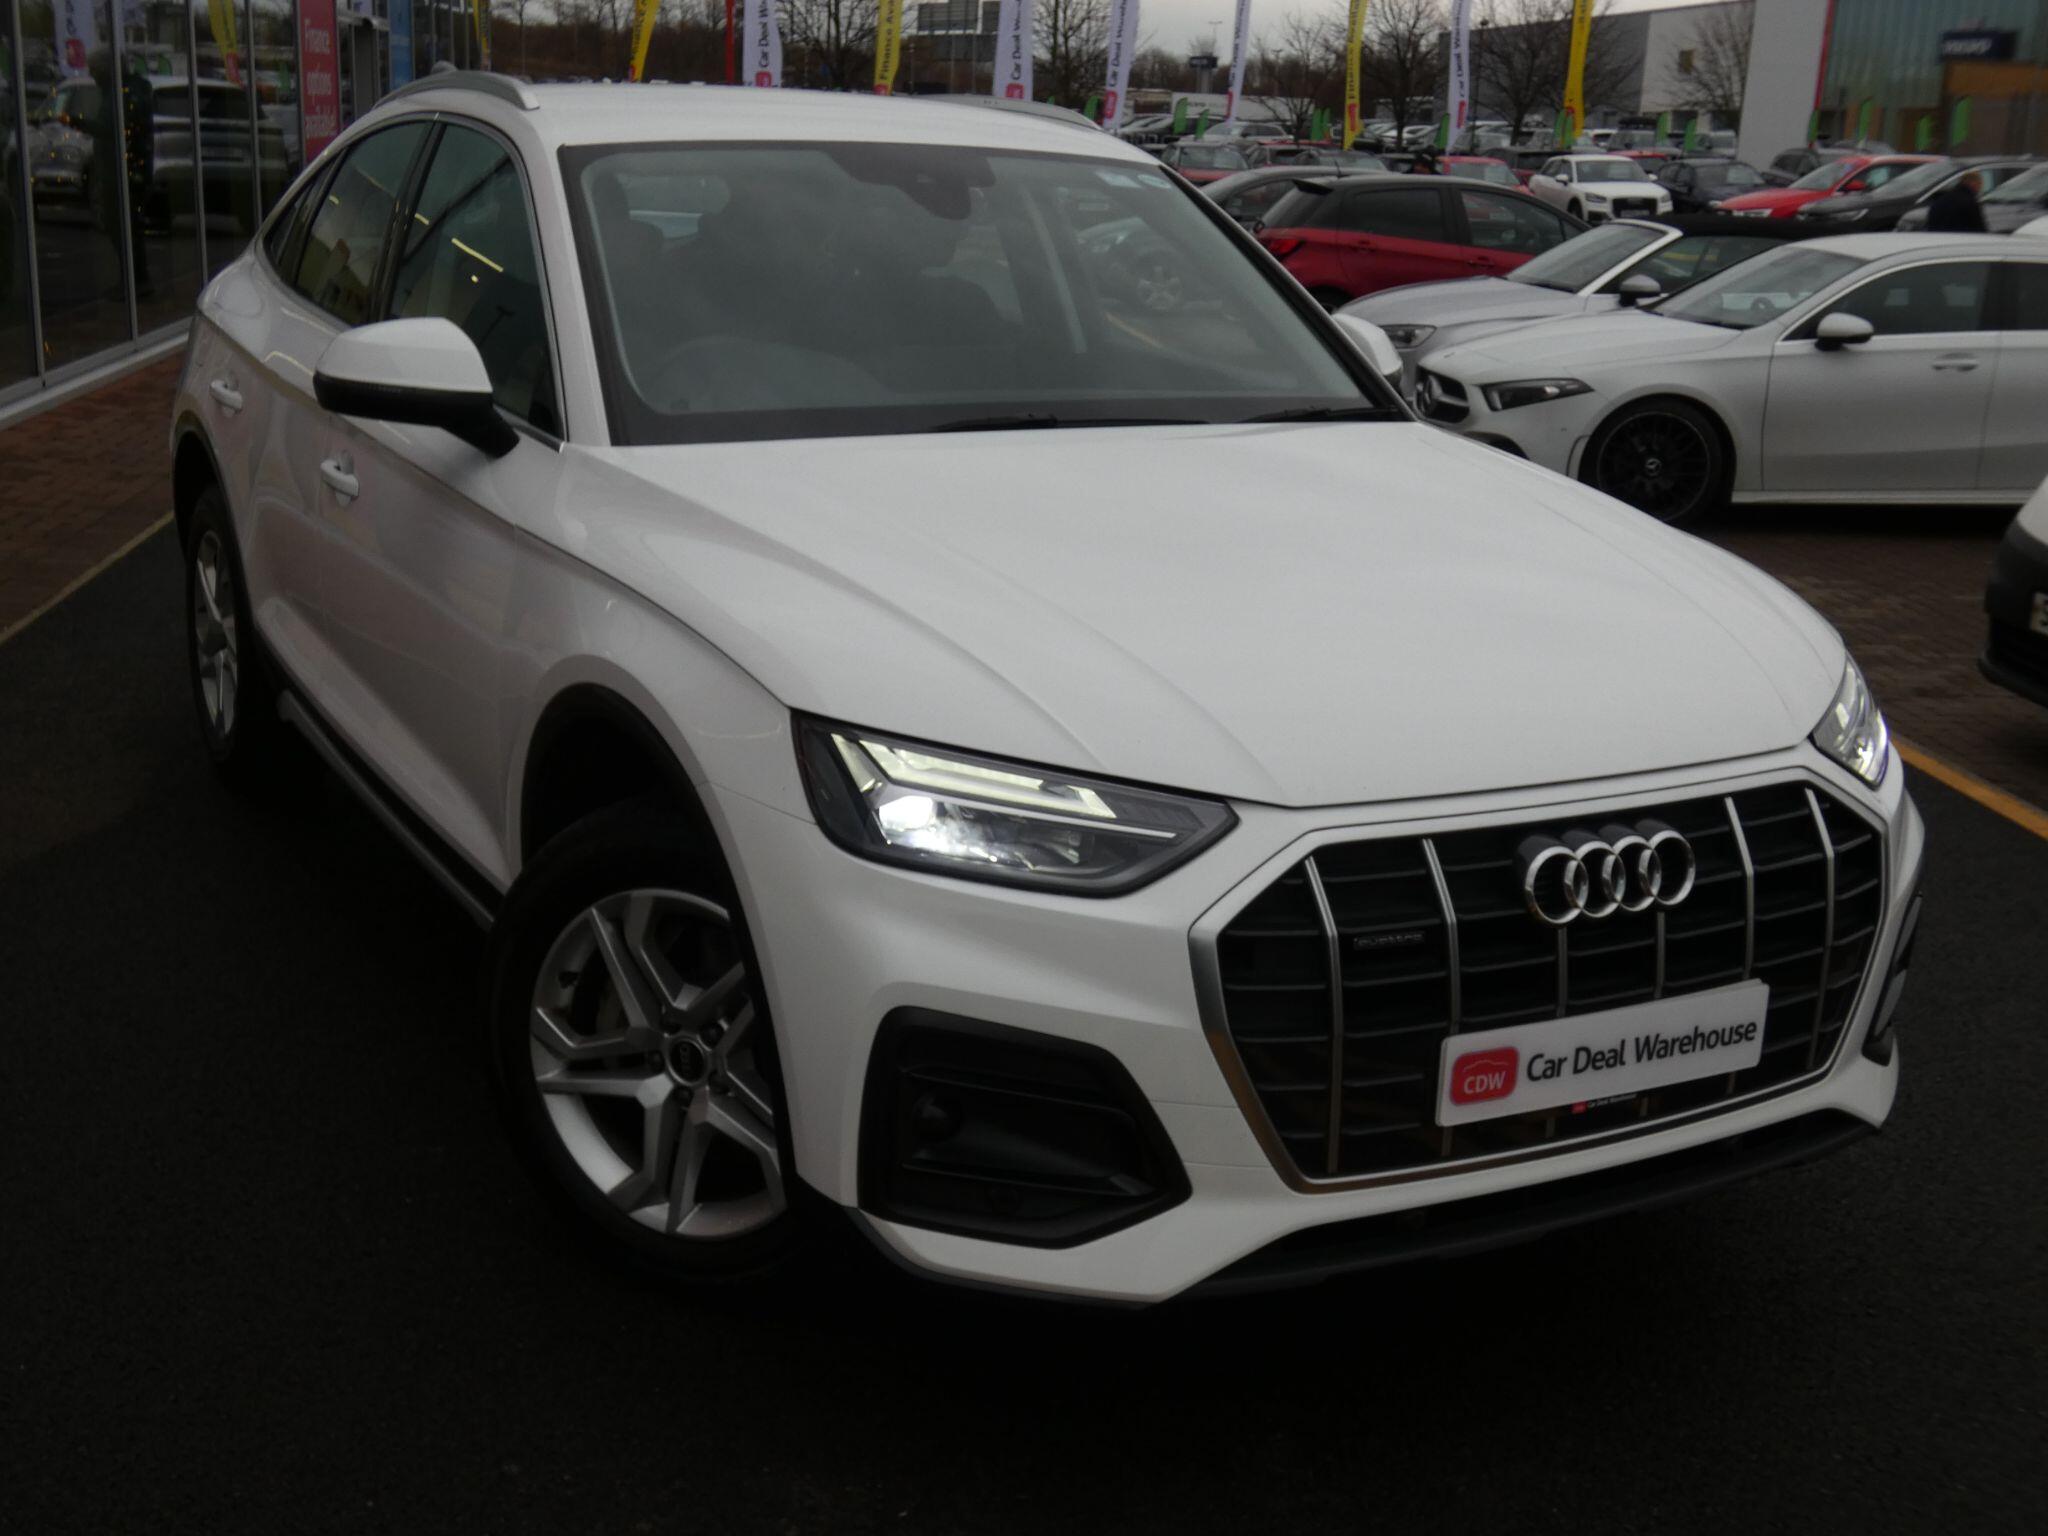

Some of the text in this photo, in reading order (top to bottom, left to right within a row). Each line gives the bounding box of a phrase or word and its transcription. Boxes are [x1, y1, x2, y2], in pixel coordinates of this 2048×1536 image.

[1011, 34, 1022, 59] Deal
[1110, 42, 1121, 67] Deal
[1010, 63, 1022, 80] Car
[1107, 70, 1117, 87] Car
[1527, 1022, 1757, 1082] Car Deal Warehouse
[1463, 1071, 1506, 1095] CDW
